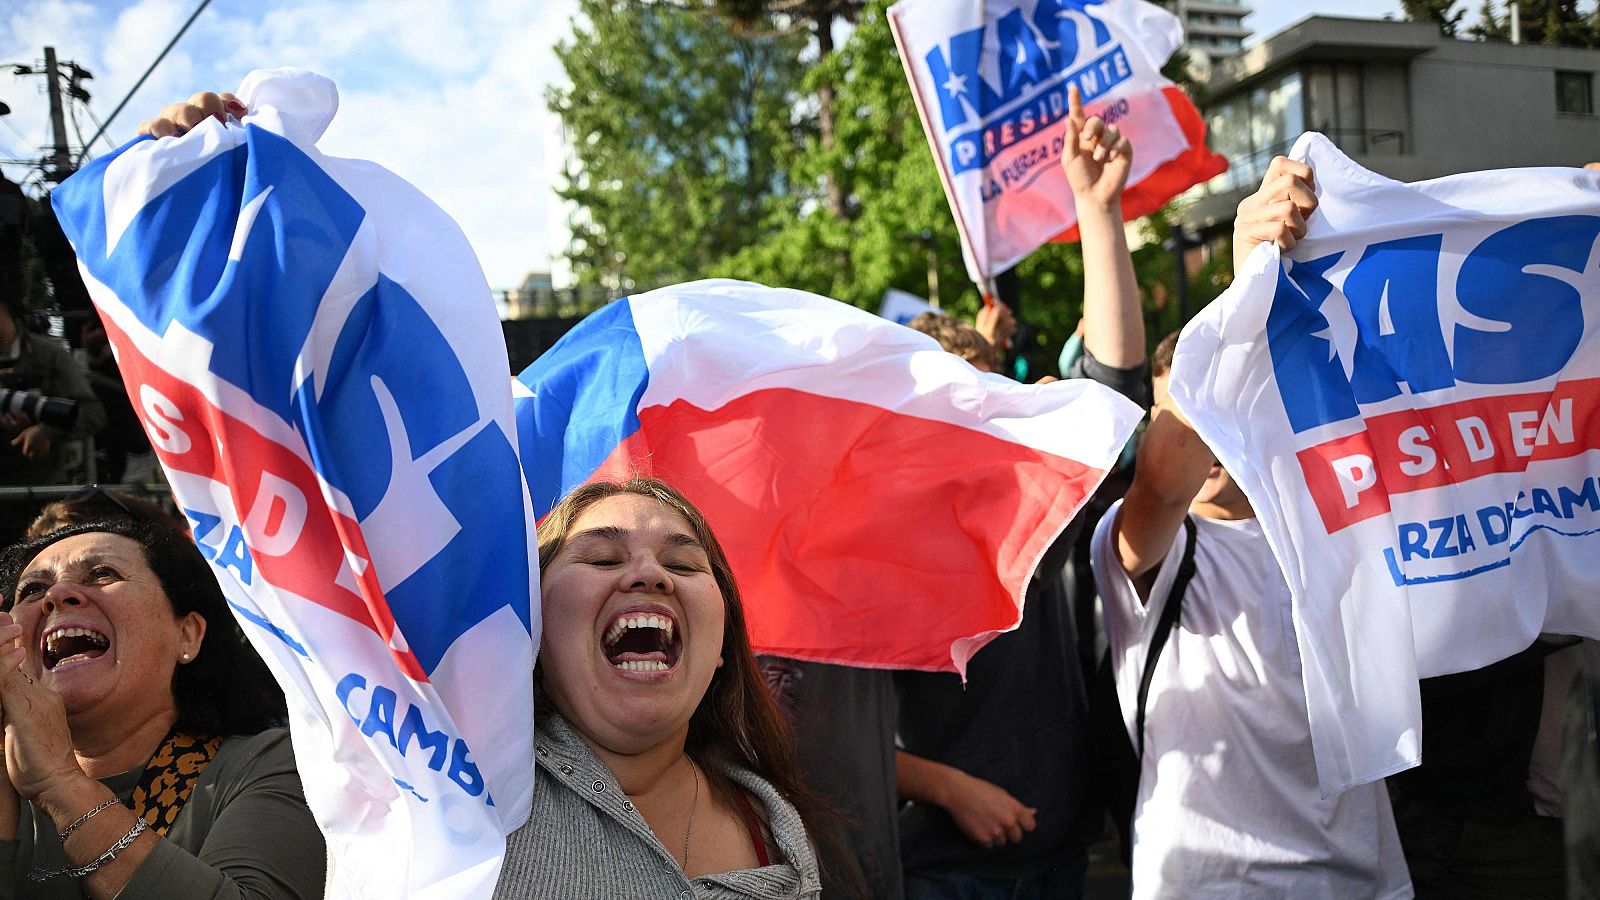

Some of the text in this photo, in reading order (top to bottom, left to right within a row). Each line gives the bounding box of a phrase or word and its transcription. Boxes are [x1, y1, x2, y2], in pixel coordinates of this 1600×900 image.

[955, 51, 1128, 167] PRESIDNTE
[1266, 215, 1600, 434] KAS
[336, 673, 495, 806] CAMB
